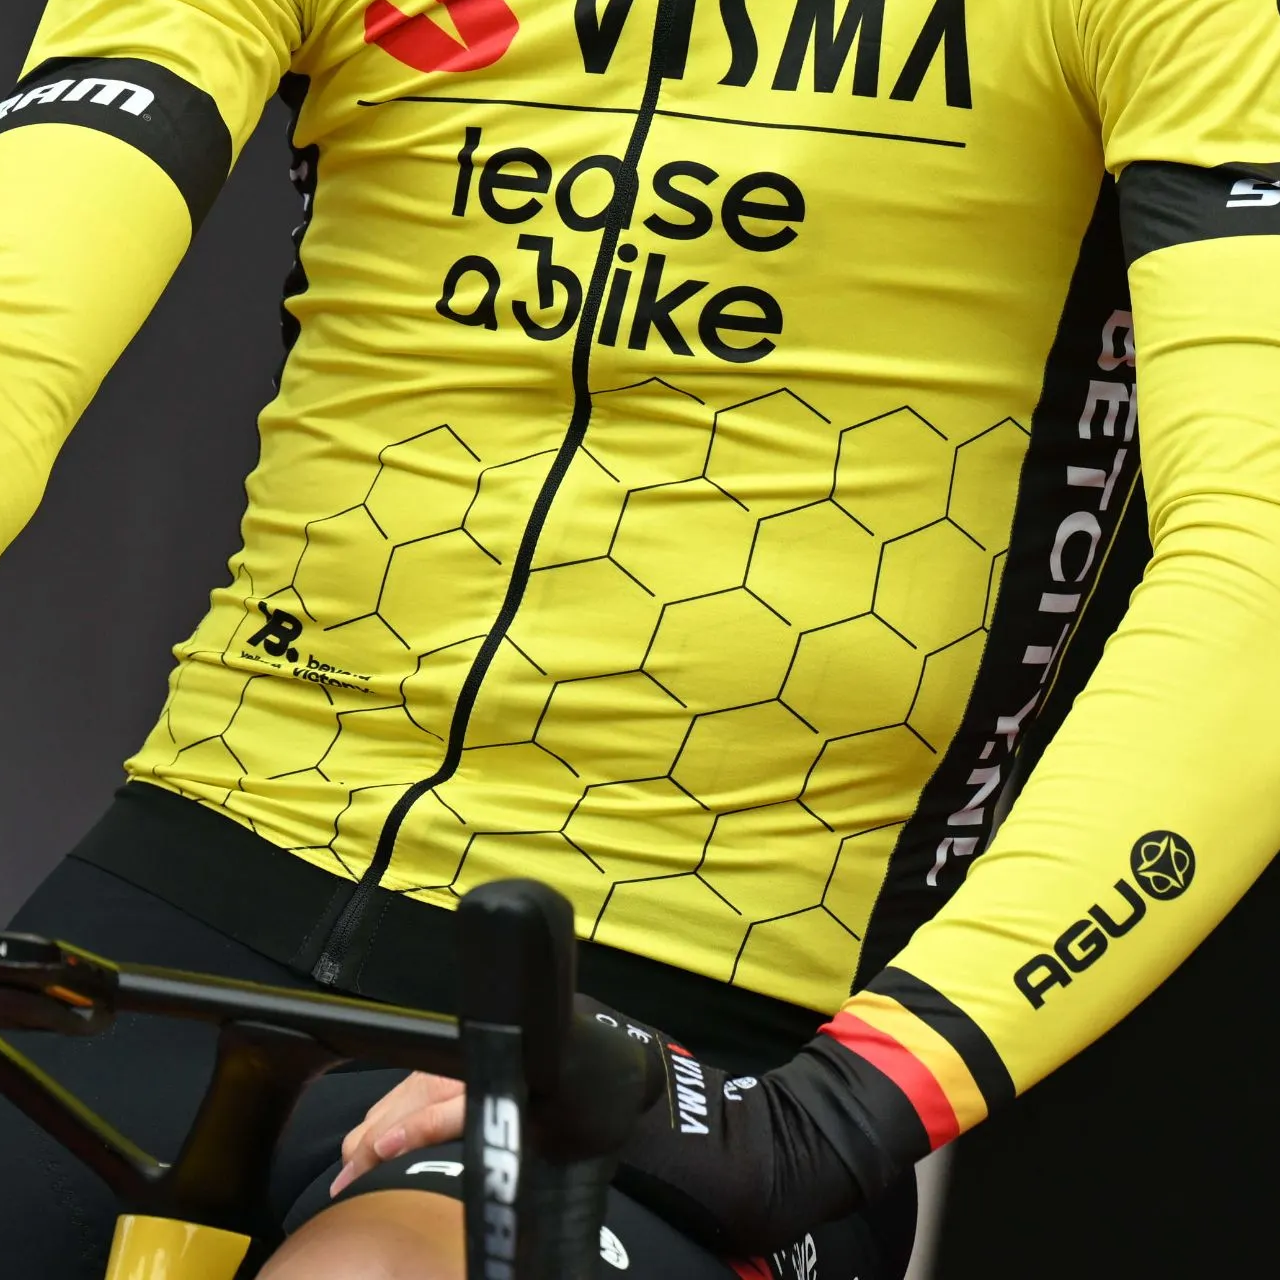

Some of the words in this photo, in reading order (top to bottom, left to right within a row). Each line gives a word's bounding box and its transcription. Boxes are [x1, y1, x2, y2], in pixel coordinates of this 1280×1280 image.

[451, 125, 807, 253] lease
[1013, 878, 1147, 1010] AGU
[670, 1054, 710, 1135] VISMA
